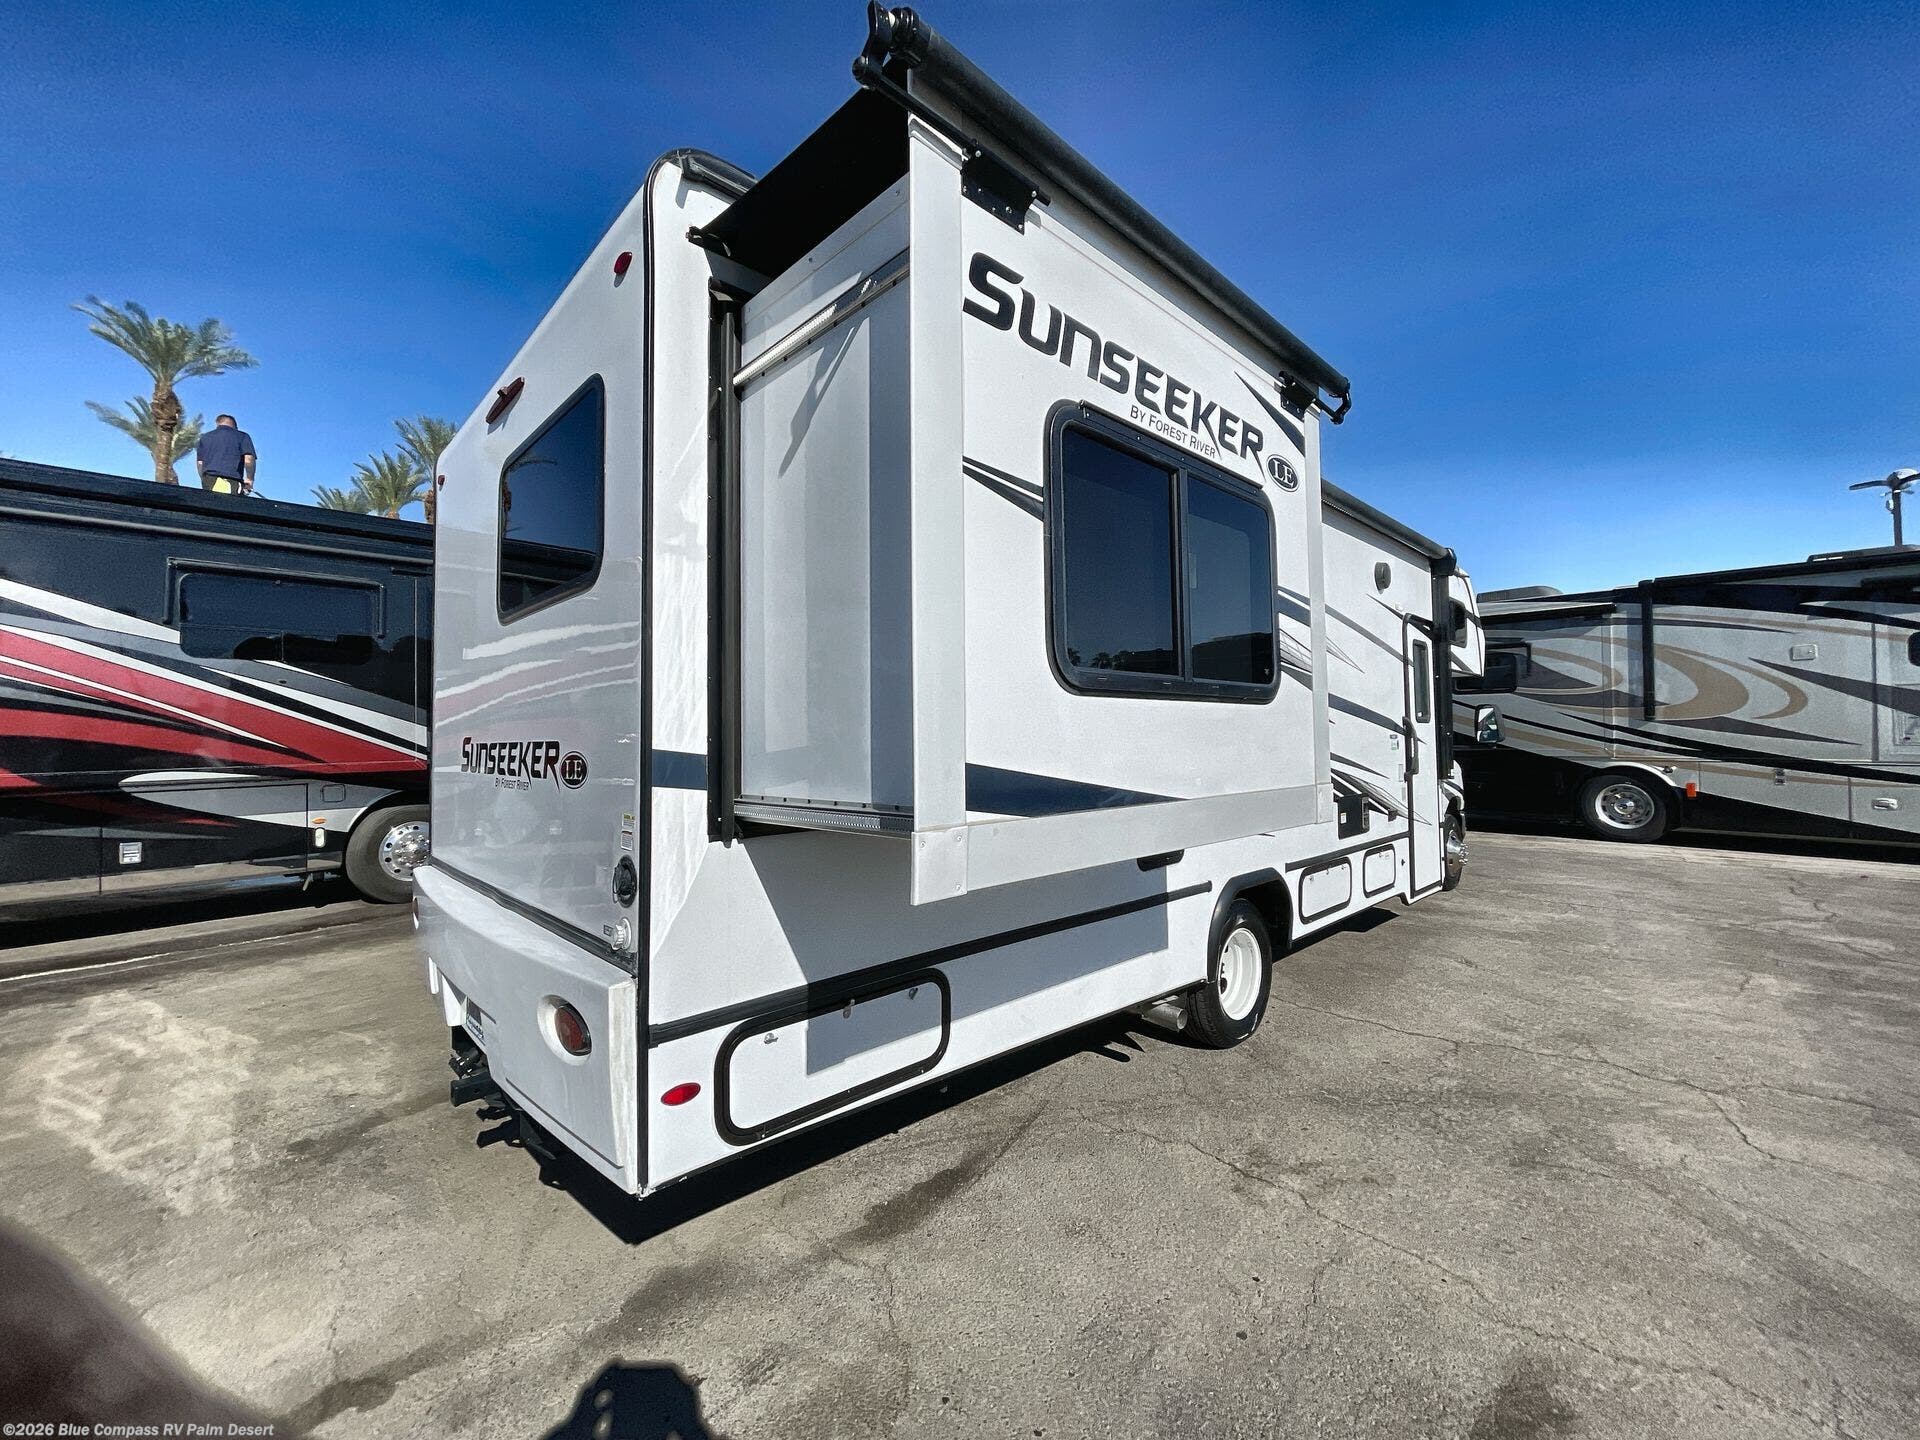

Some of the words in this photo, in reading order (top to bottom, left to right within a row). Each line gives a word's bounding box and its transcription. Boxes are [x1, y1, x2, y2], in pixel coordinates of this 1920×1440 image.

[1130, 404, 1147, 423] BY
[1148, 413, 1188, 444] FOREST
[1189, 435, 1216, 459] RIVER
[1271, 457, 1296, 488] LE
[565, 758, 582, 780] LE
